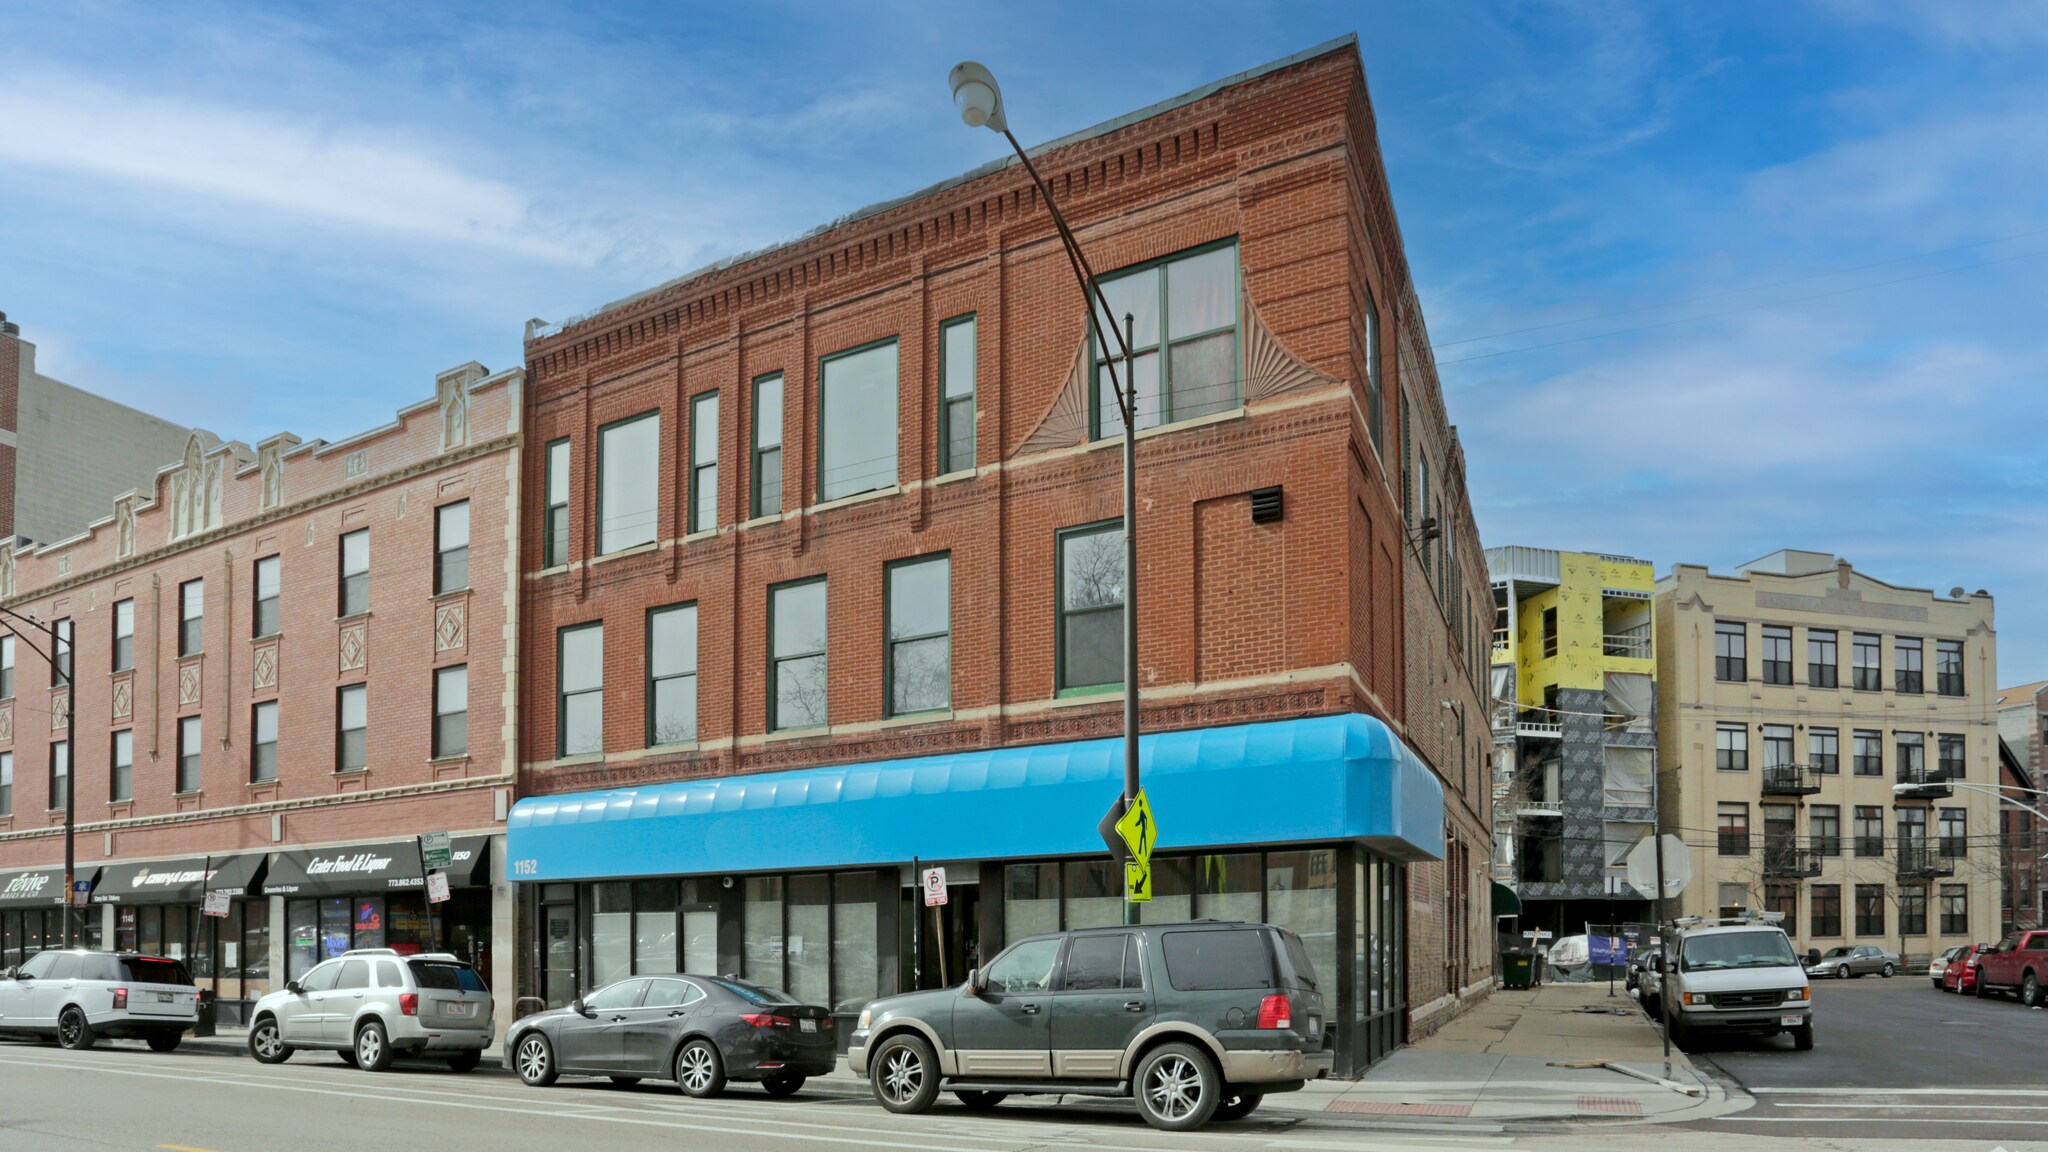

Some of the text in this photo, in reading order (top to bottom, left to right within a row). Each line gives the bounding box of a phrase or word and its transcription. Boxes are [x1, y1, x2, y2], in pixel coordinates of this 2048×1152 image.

[306, 853, 392, 874] Crater Food & Liquor
[453, 851, 471, 860] 1150
[514, 859, 537, 875] 1152
